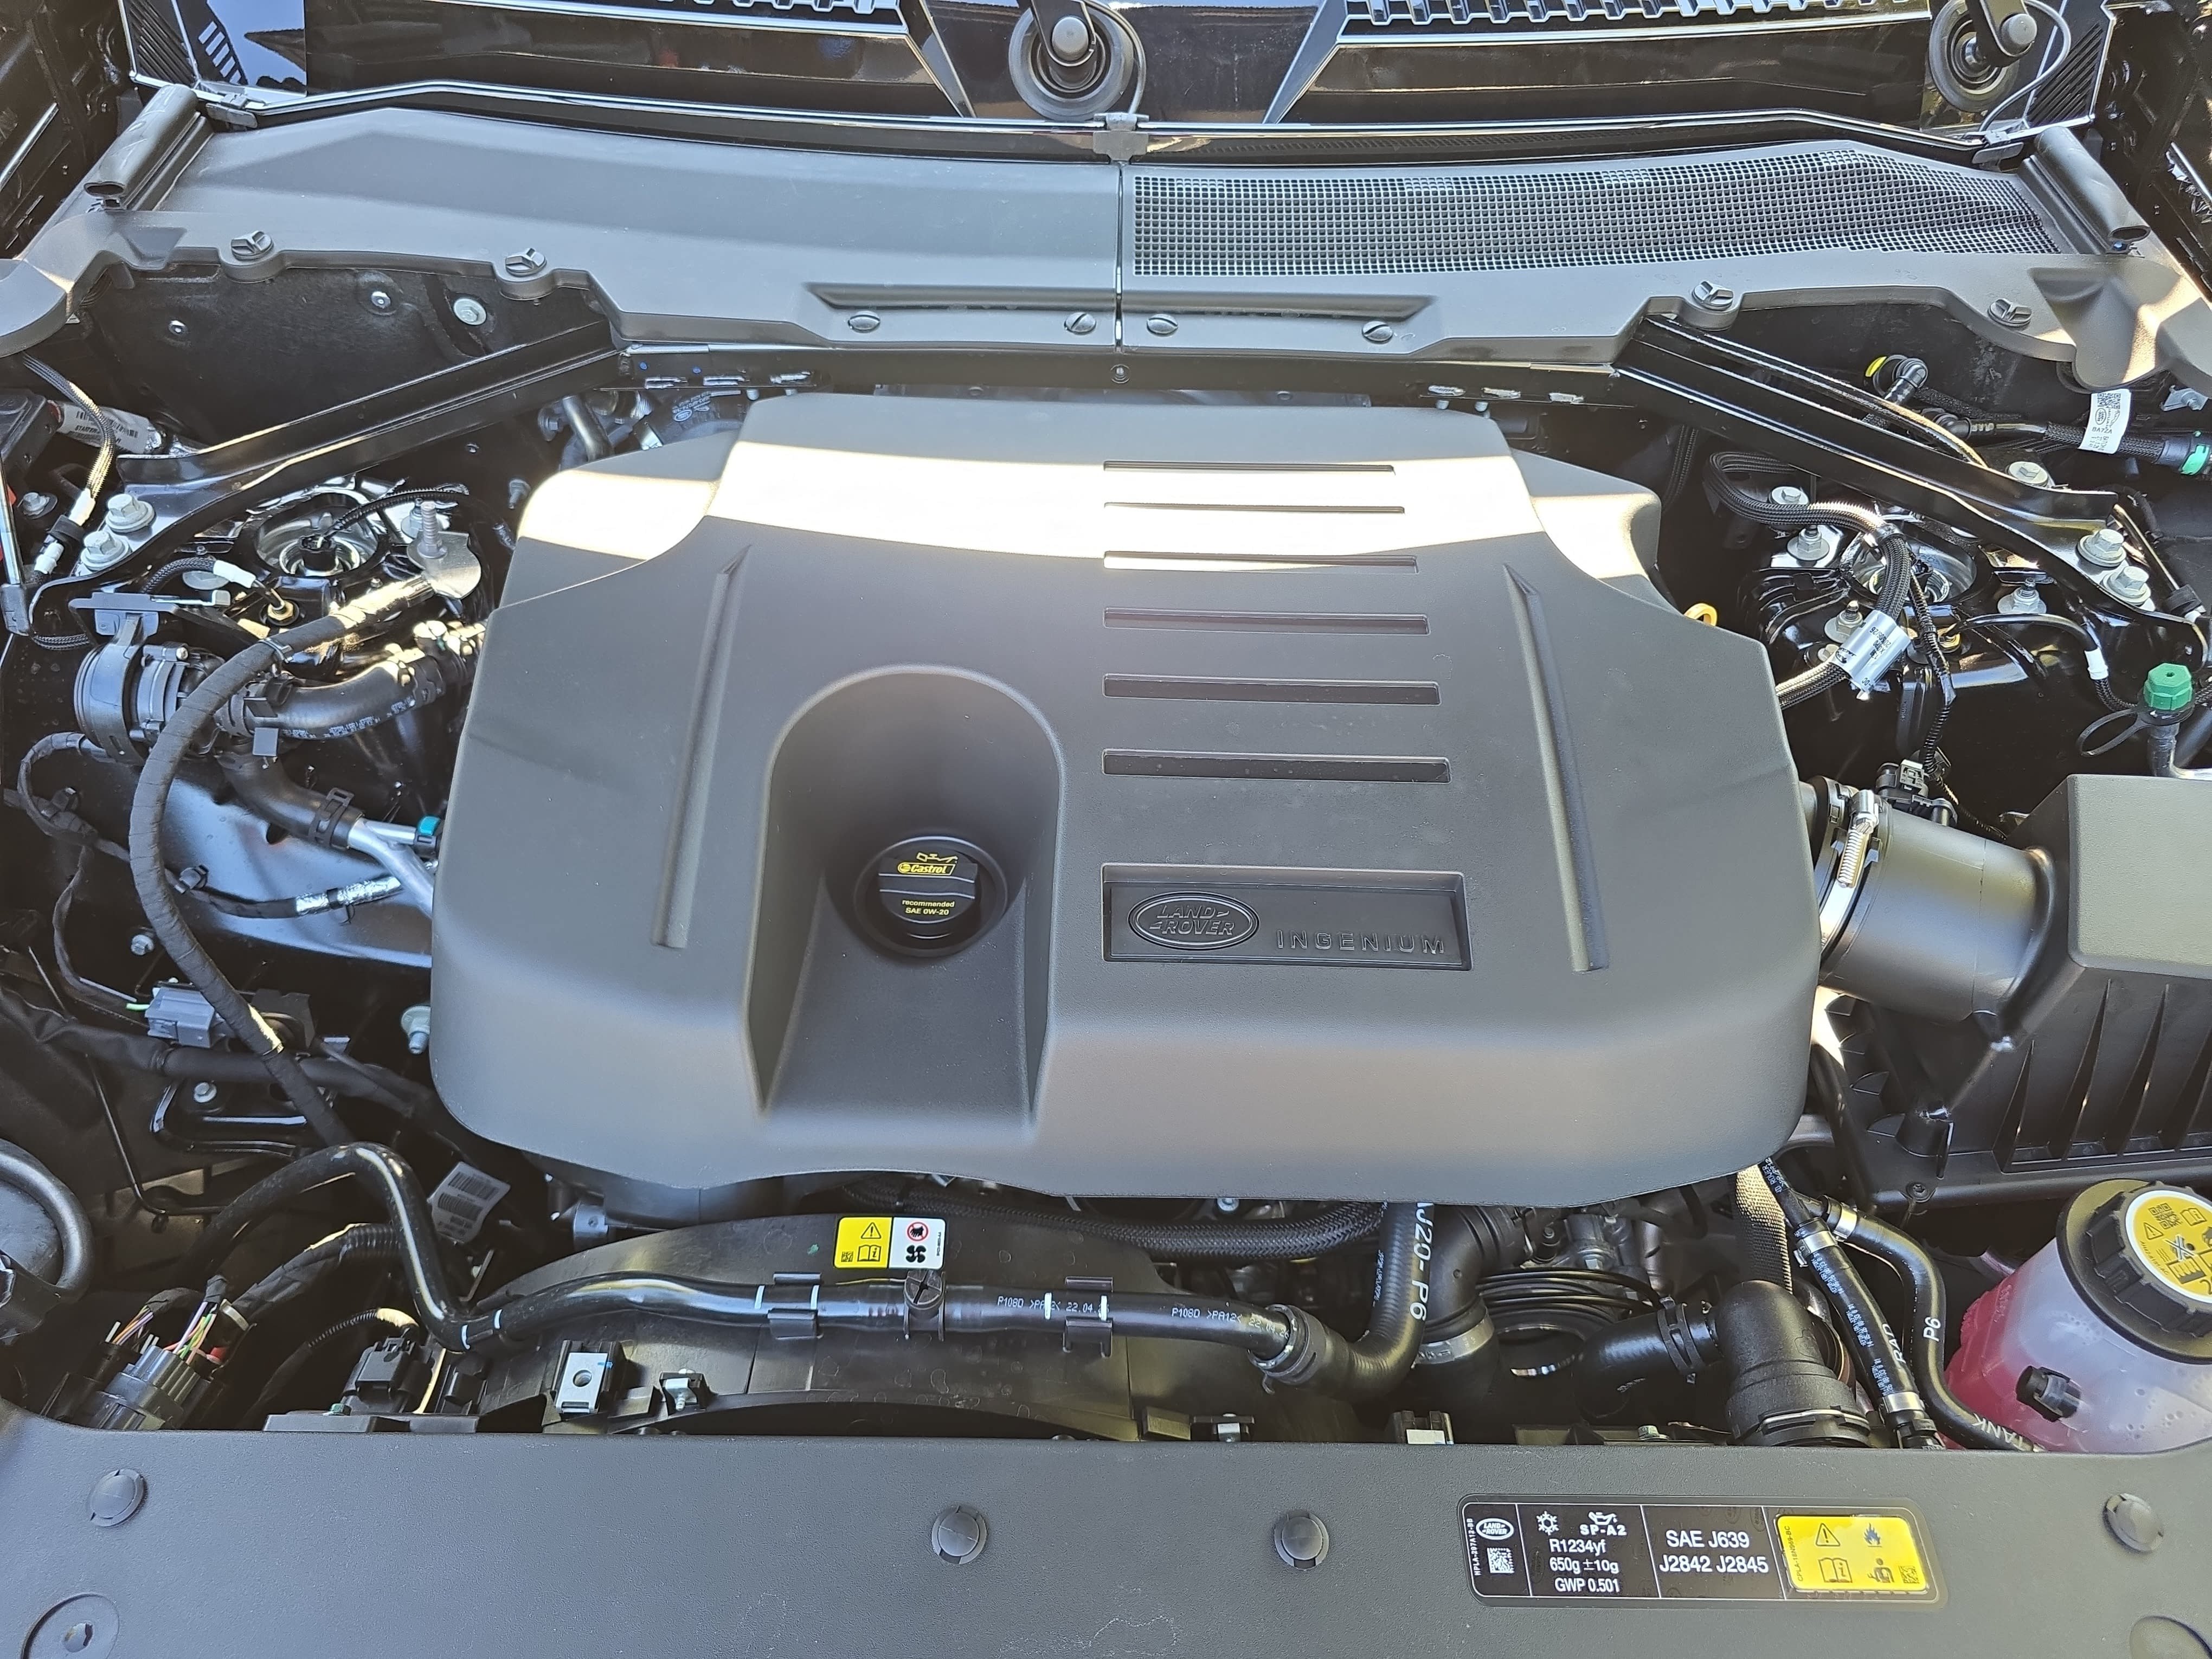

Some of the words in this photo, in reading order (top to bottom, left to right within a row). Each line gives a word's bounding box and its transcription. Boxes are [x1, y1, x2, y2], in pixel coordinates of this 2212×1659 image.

[910, 864, 946, 874] Castrol
[902, 899, 955, 908] recommended
[1156, 904, 1216, 919] LAND
[1162, 920, 1236, 936] ROVER
[1276, 929, 1445, 954] INGENIUM
[1414, 1202, 1435, 1271] J20-
[997, 1296, 1024, 1308] P108D
[1030, 1299, 1061, 1311] >PA2<
[1410, 1279, 1430, 1321] P6
[1171, 1307, 1201, 1319] P108D
[1923, 1316, 1941, 1342] P6
[1579, 1524, 1627, 1535] SP-A2
[1549, 1538, 1606, 1556] R1234yf
[1666, 1530, 1705, 1547] SAE
[1708, 1531, 1750, 1548] J639
[1549, 1557, 1581, 1574] 650g
[1659, 1554, 1713, 1572] J2842
[1716, 1555, 1769, 1573] J2845
[1554, 1577, 1585, 1592] GWP
[1588, 1578, 1620, 1592] 0.501
